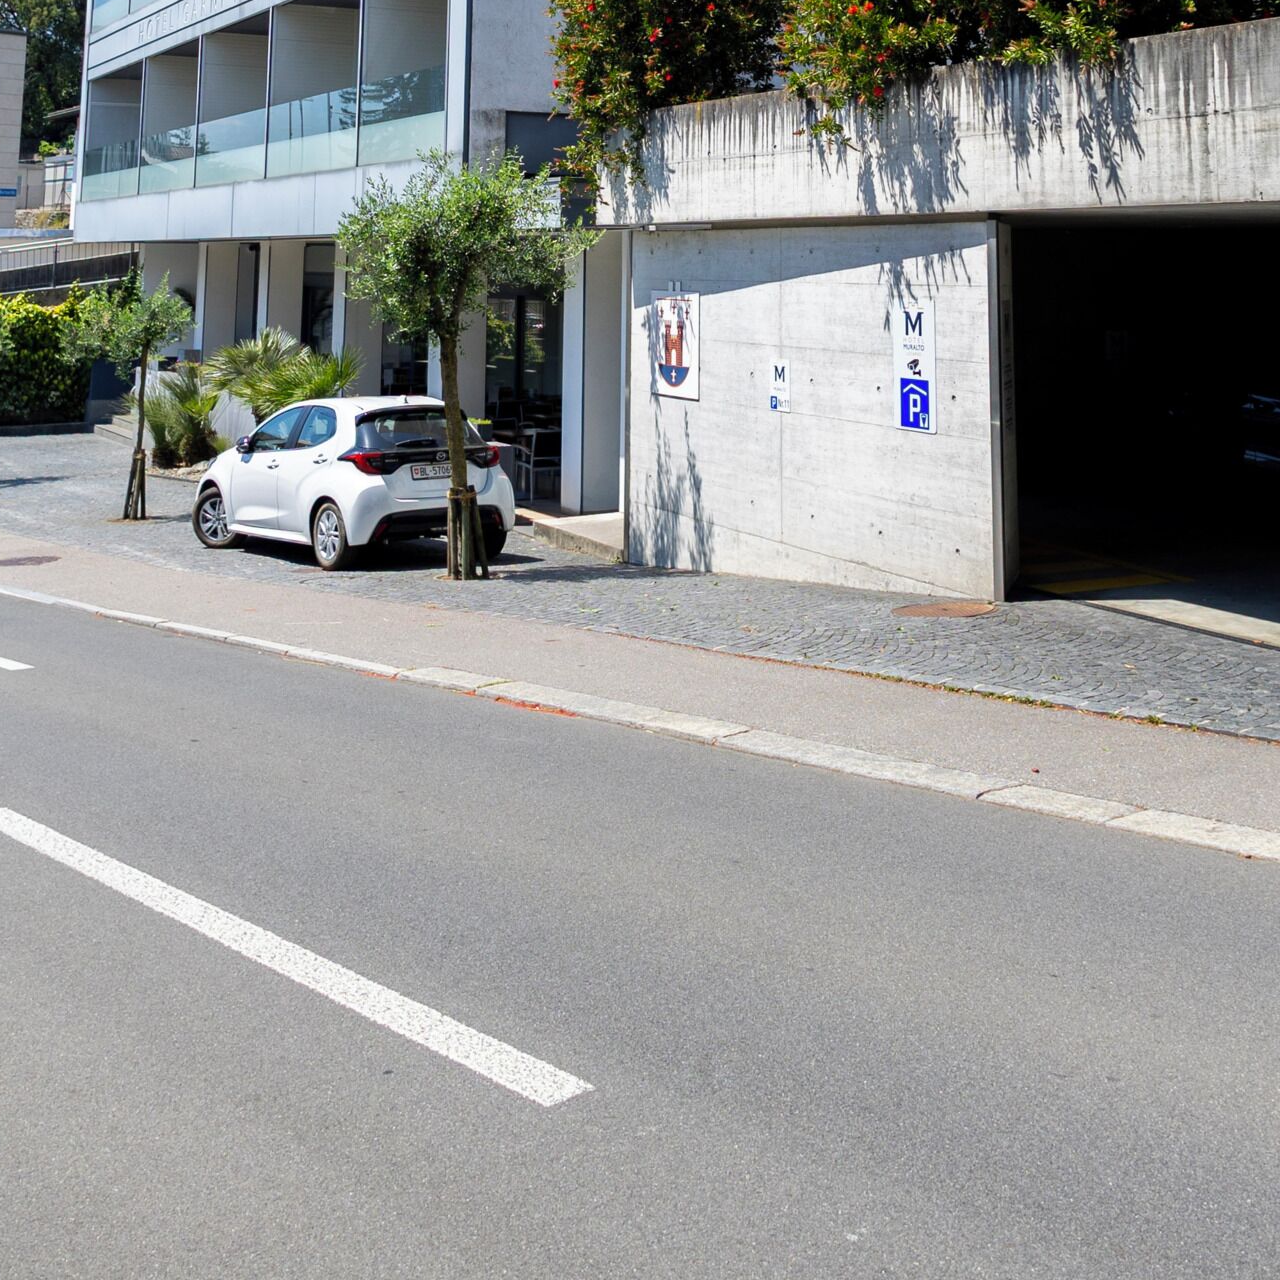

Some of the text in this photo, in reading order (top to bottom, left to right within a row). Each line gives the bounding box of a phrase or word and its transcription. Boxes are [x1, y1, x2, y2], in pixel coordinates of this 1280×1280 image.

[137, 9, 175, 44] HOTEL
[904, 311, 924, 336] M
[774, 365, 786, 383] M
[909, 393, 921, 422] P
